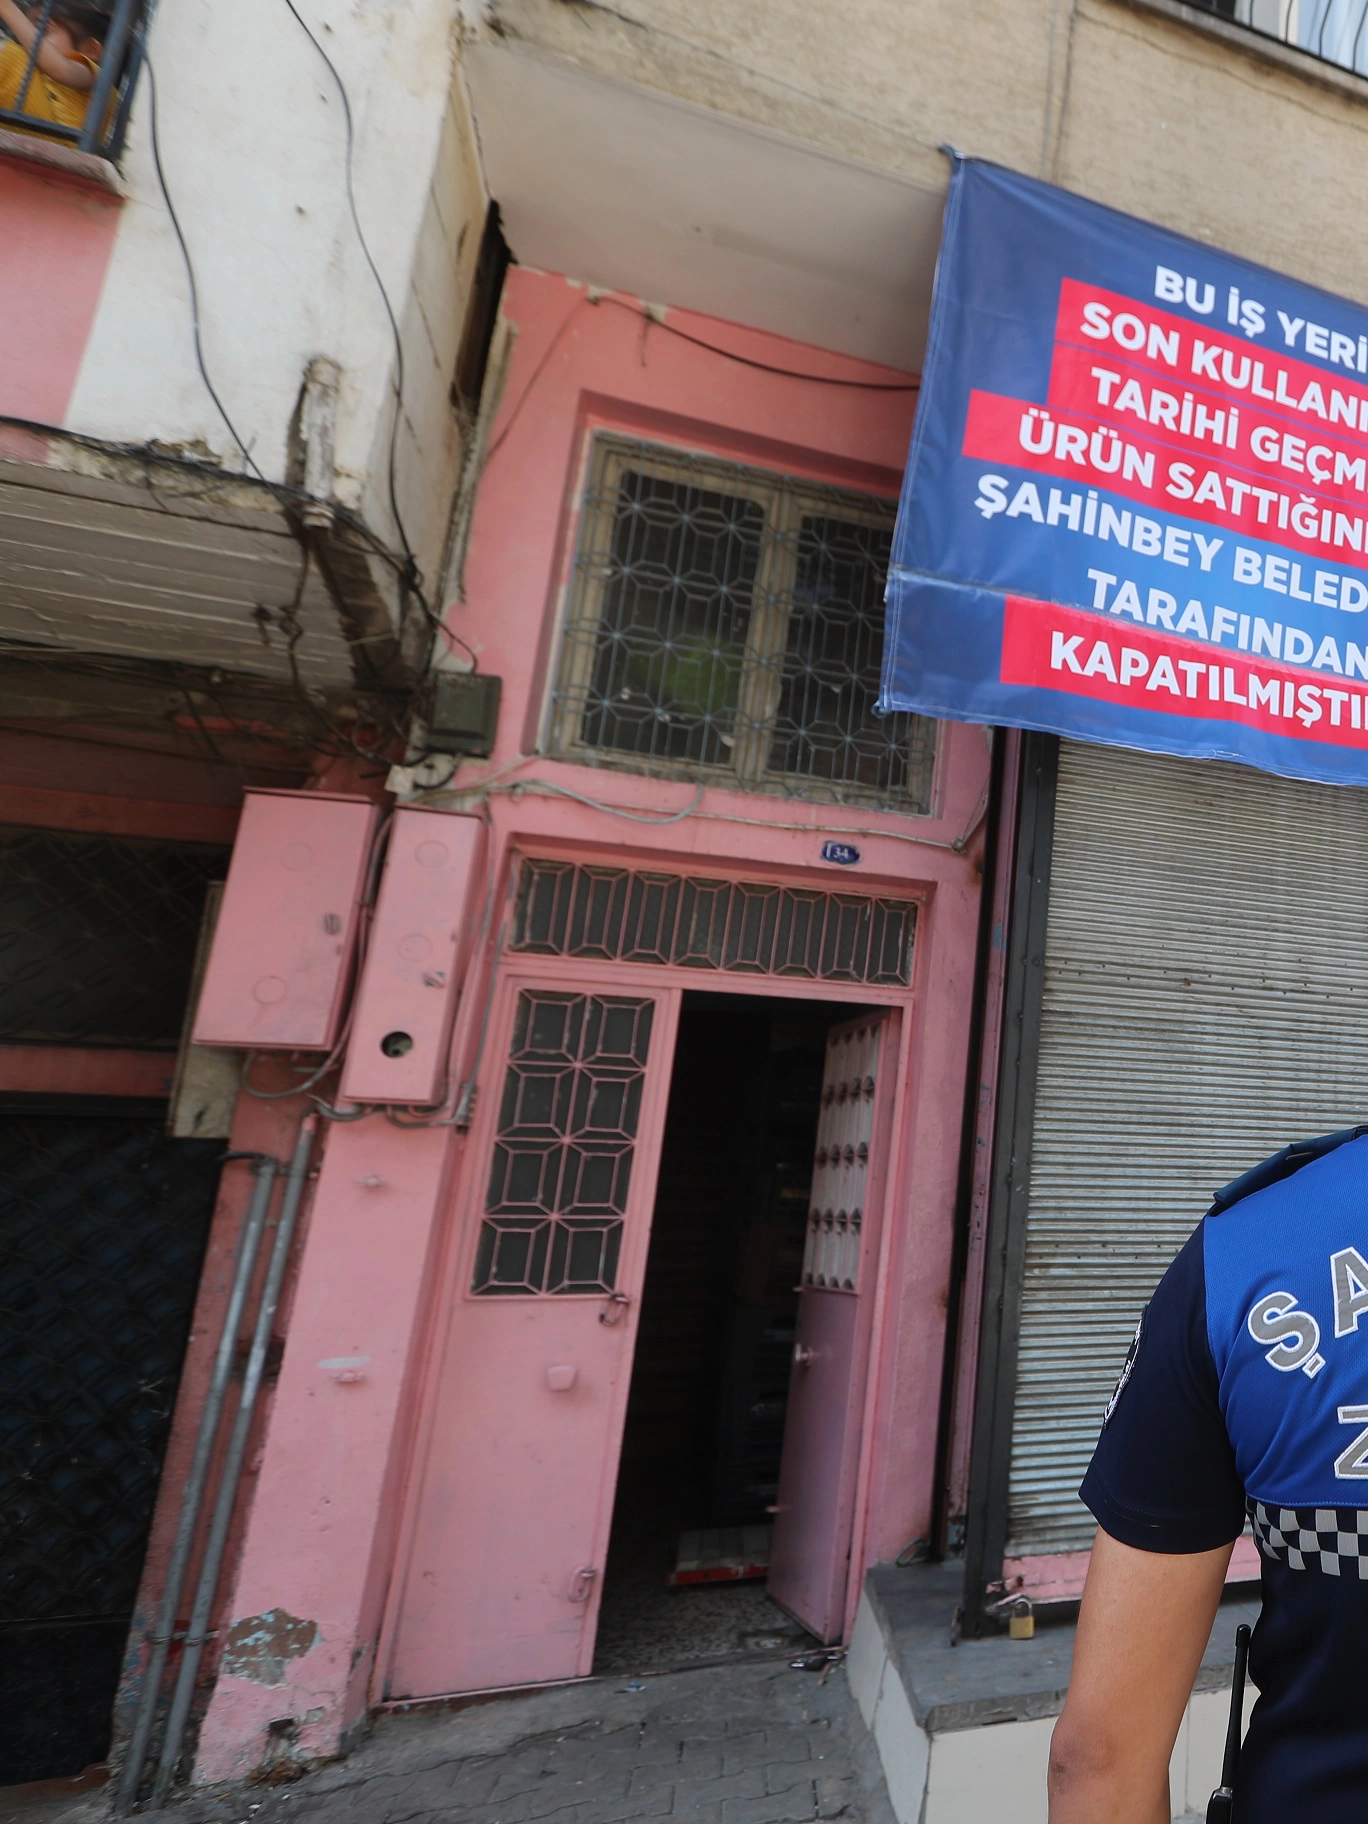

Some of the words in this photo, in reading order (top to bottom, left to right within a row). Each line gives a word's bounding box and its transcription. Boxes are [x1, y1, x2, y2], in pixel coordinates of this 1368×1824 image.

[1081, 302, 1180, 366] SON
[1154, 266, 1216, 314] BU
[1226, 286, 1266, 338] İŞ
[1277, 311, 1368, 374] YERİ
[1018, 408, 1156, 488] ÜRÜN
[1091, 366, 1240, 449] TARİHİ
[974, 474, 1224, 573] ŞAHİNBEY
[833, 847, 849, 859] 34
